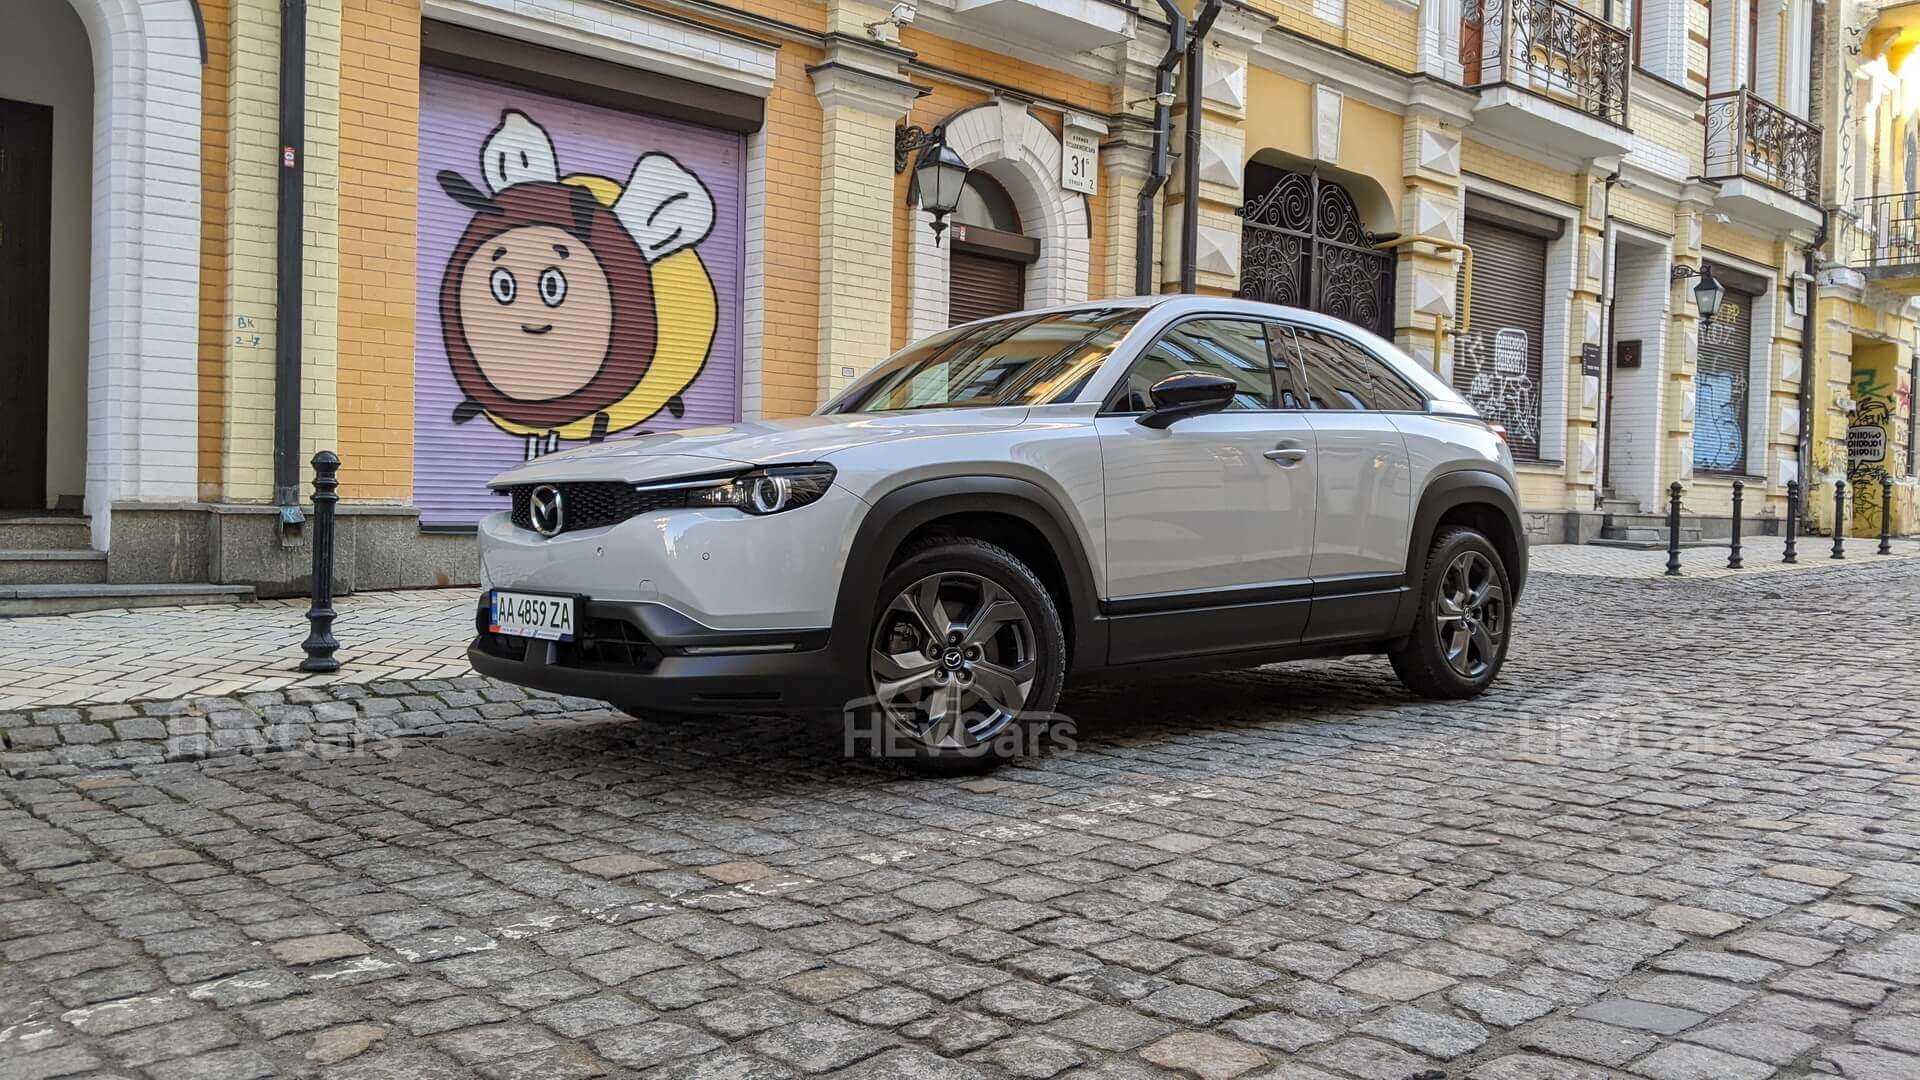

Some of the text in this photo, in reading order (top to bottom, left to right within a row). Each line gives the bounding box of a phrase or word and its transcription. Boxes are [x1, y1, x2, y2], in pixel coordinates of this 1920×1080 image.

[498, 597, 570, 630] AA 4859 ZA
